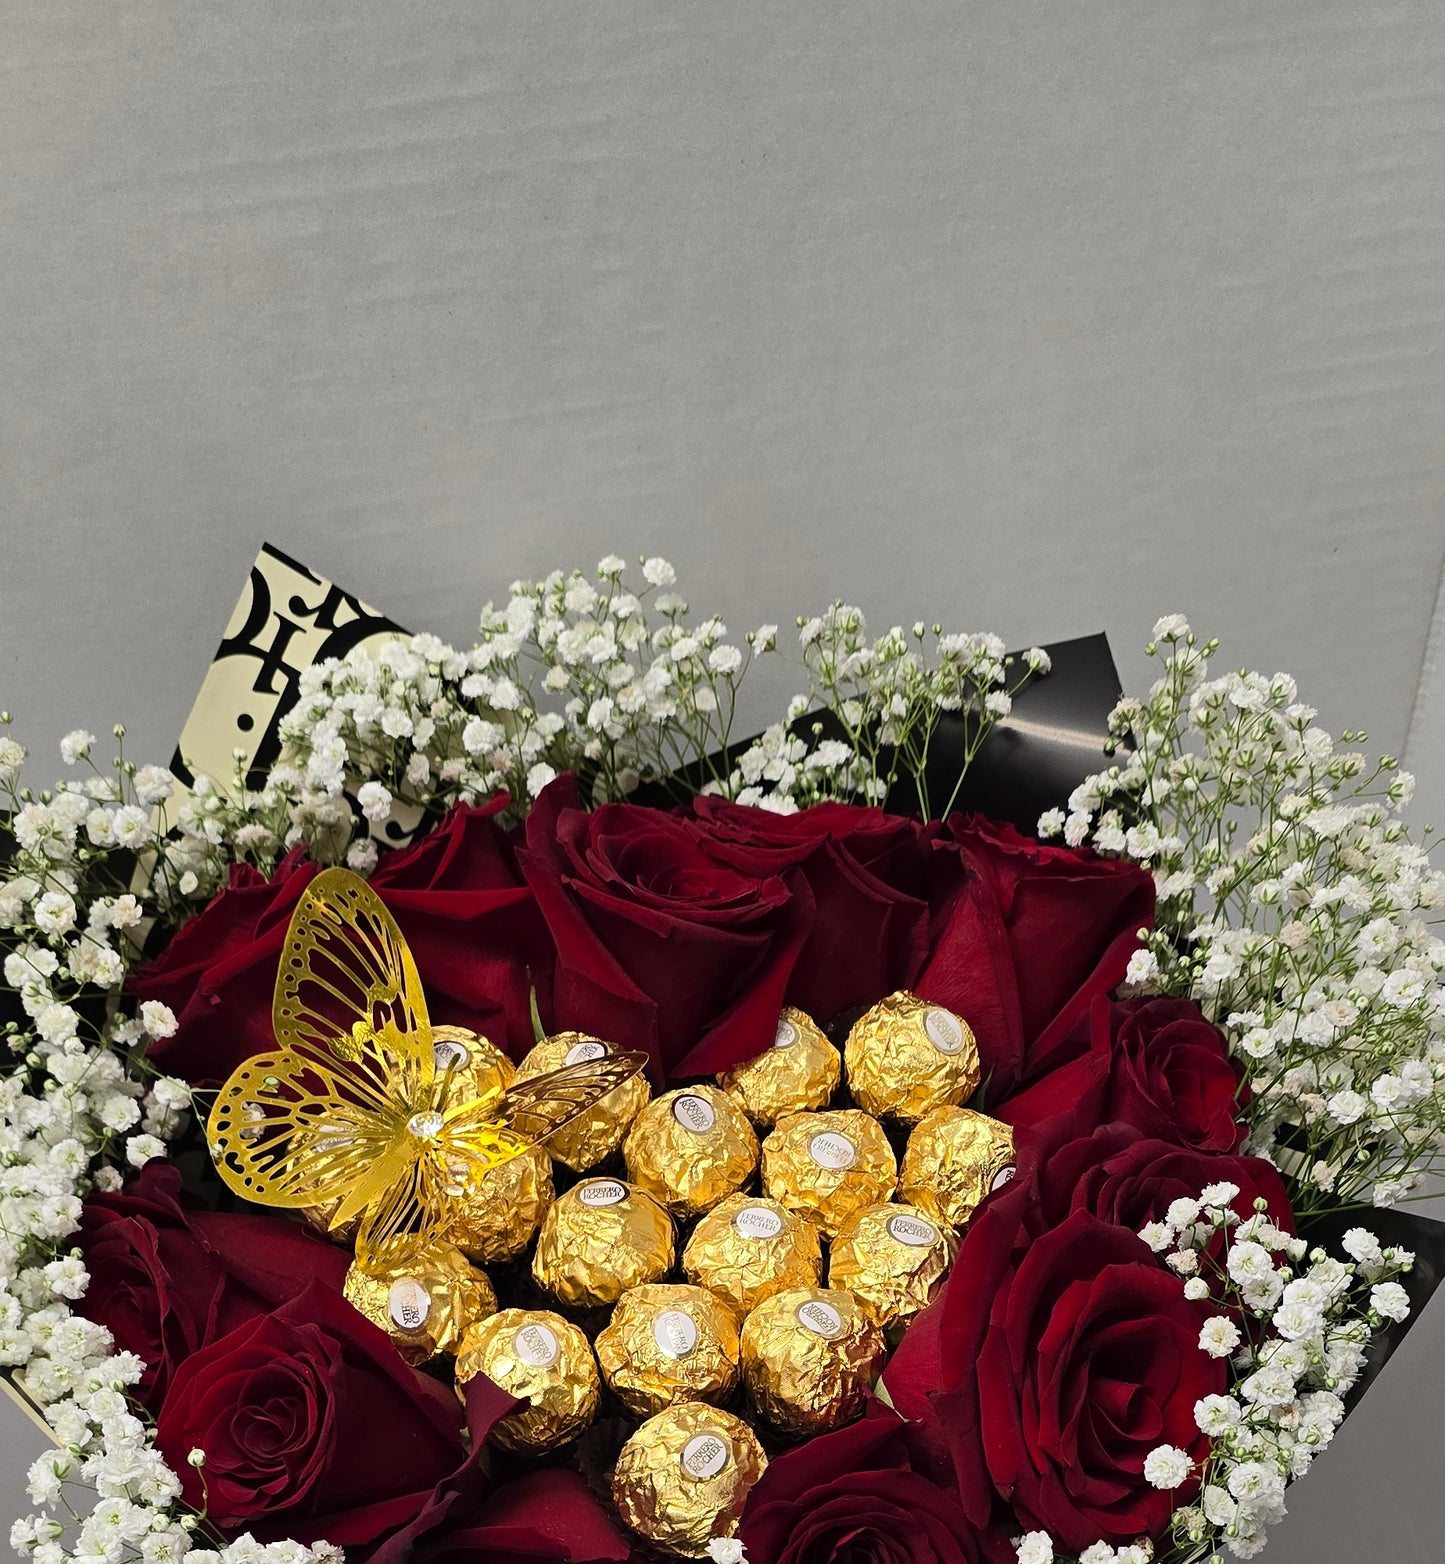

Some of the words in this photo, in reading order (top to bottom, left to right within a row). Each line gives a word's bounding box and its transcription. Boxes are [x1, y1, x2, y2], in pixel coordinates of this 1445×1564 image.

[679, 1101, 703, 1130] ROCHER
[687, 1098, 710, 1127] FERRERO
[583, 1186, 622, 1196] FERRERO
[583, 1191, 622, 1200] ROCHER
[739, 1219, 777, 1232] ROCHER
[741, 1212, 779, 1226] FERRERO
[895, 1219, 932, 1235] FERRERO
[893, 1225, 930, 1240] ROCHER
[521, 1331, 544, 1363] ROCHER
[529, 1326, 552, 1359] FERRERO
[686, 1437, 716, 1467] FERRERO
[693, 1443, 724, 1474] ROCHER
